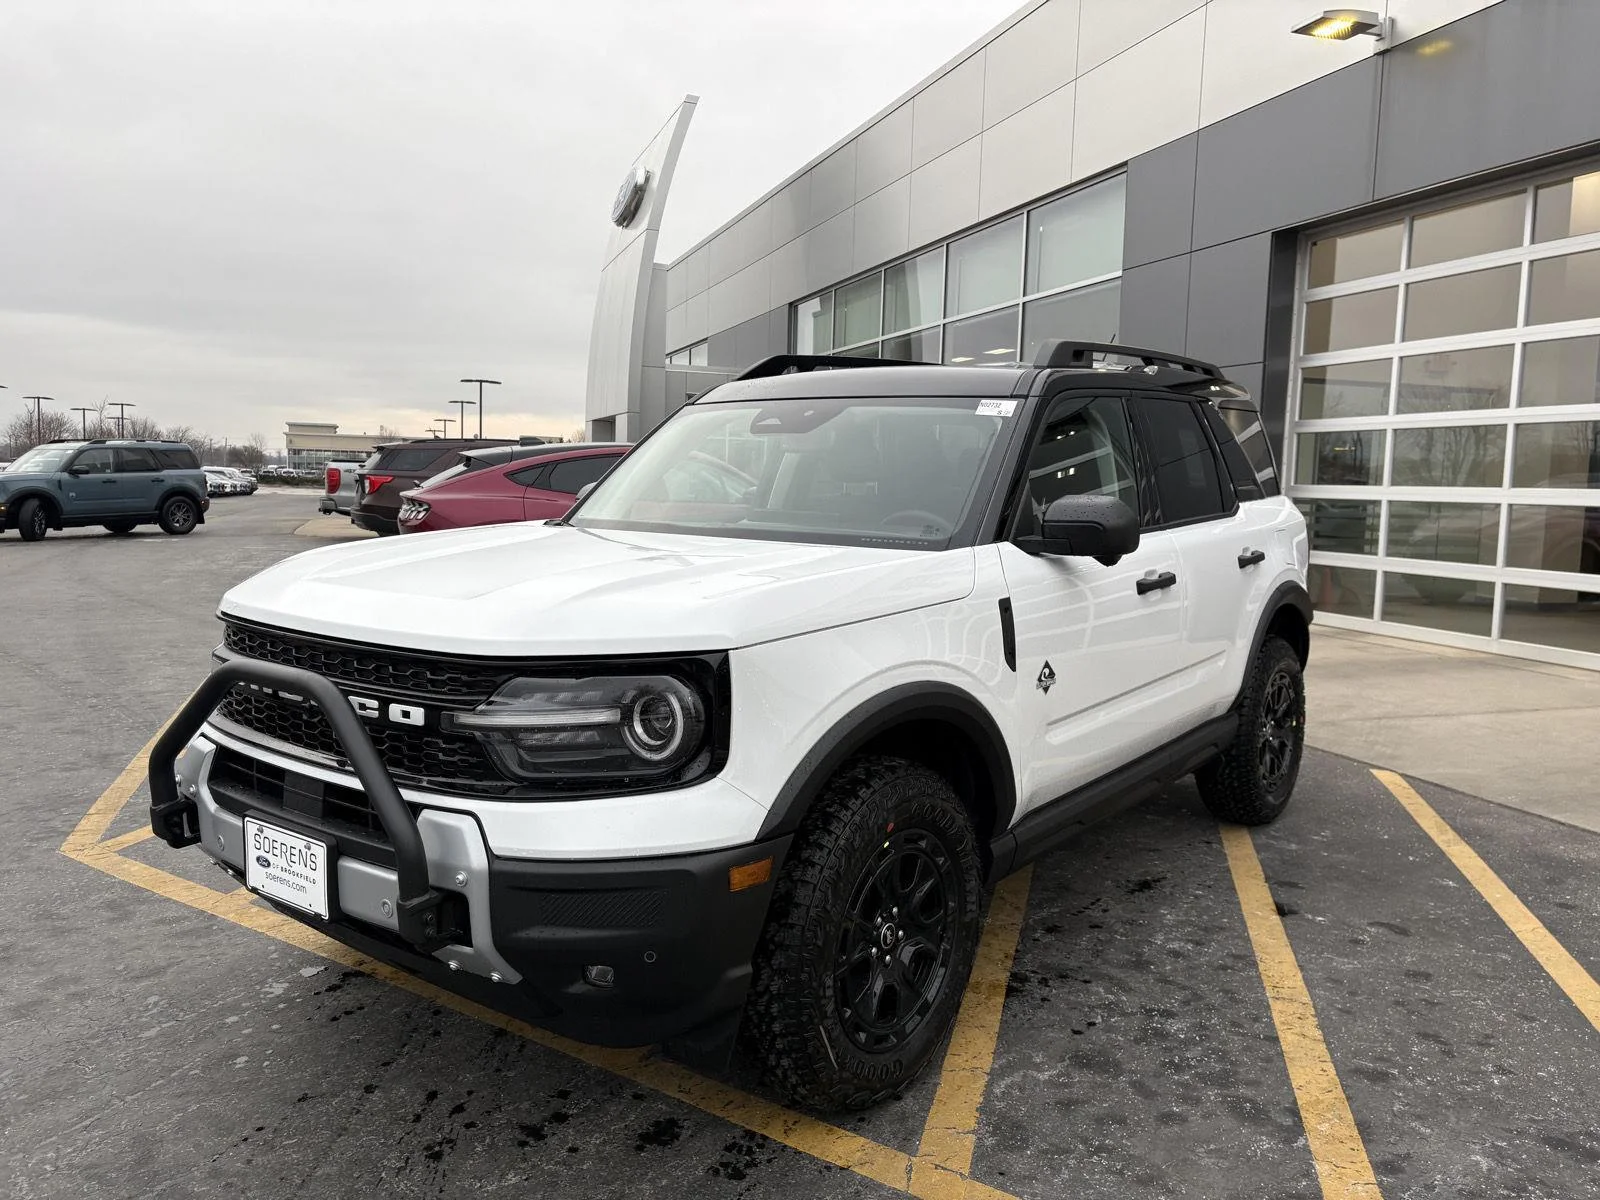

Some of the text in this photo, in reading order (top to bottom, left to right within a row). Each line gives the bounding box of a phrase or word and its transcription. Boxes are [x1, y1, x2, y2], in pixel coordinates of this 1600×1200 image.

[253, 833, 317, 871] SOERENS
[265, 871, 307, 893] soerens.com
[280, 866, 317, 885] BROOKFIELD
